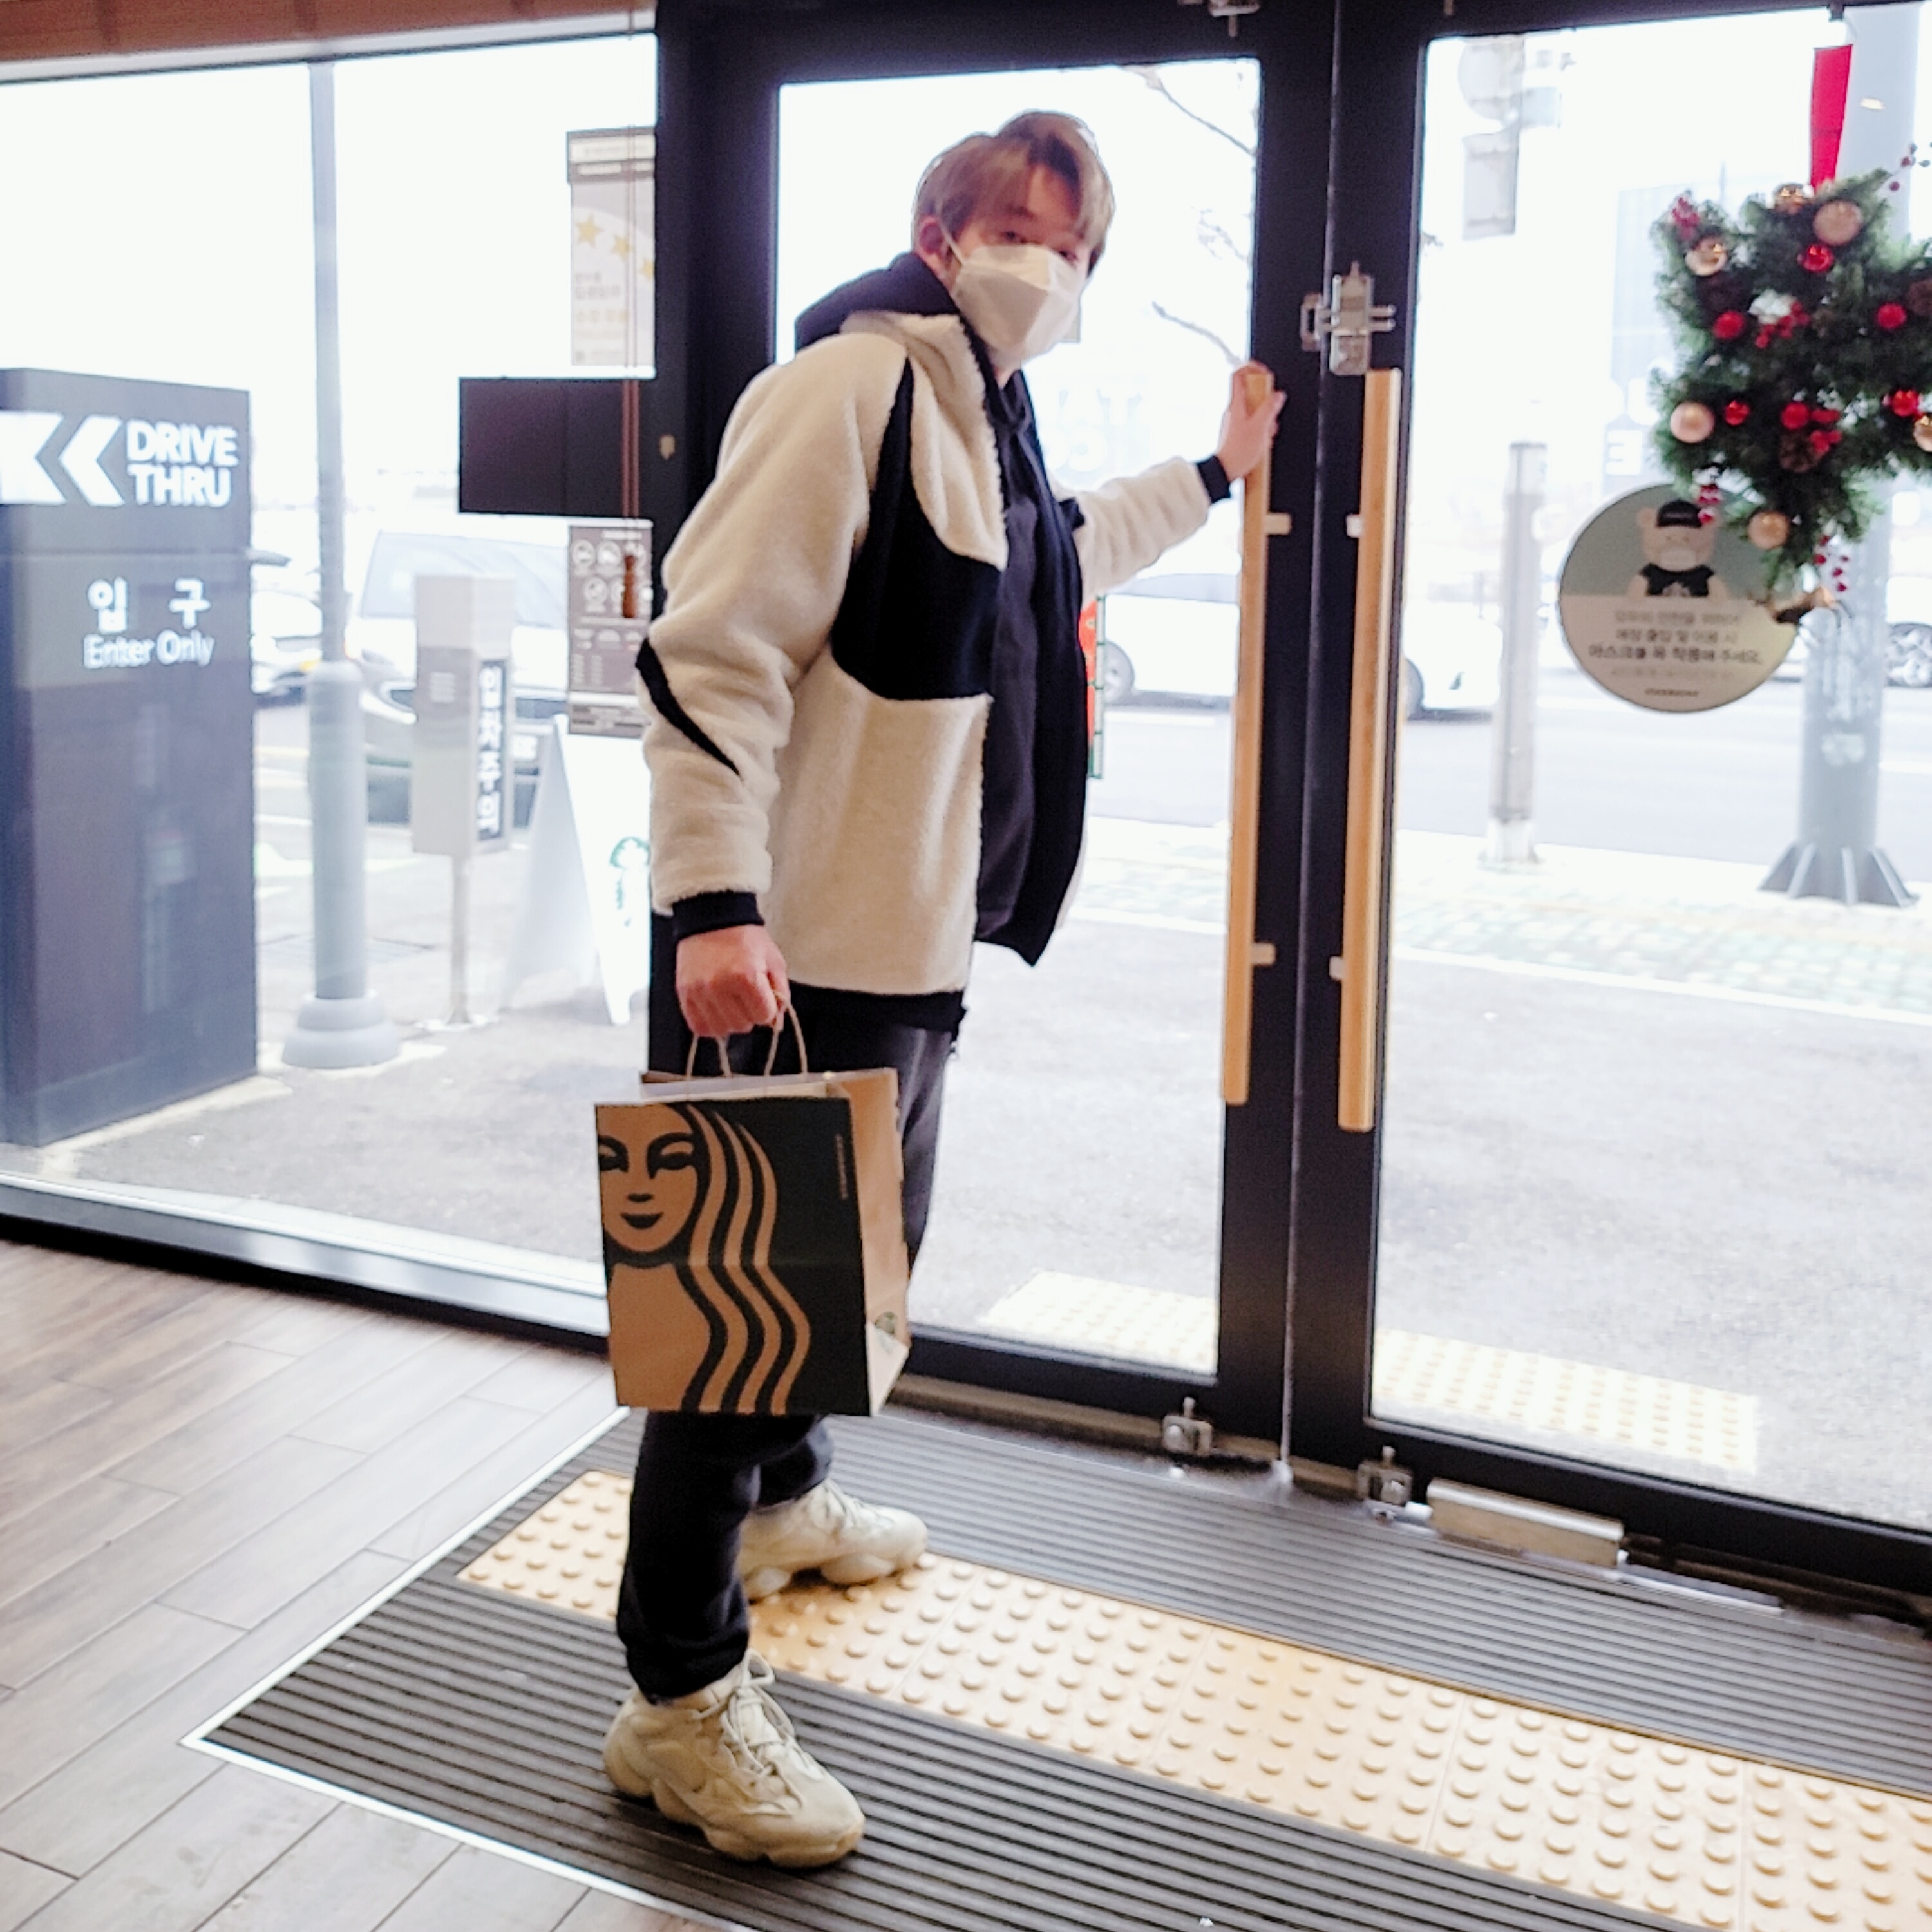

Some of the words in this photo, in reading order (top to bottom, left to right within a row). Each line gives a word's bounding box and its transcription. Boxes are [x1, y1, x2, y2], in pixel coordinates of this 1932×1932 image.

[127, 419, 239, 466] DRIVE
[127, 464, 232, 507] THRU
[84, 634, 155, 669] Enter
[156, 629, 215, 667] Only
